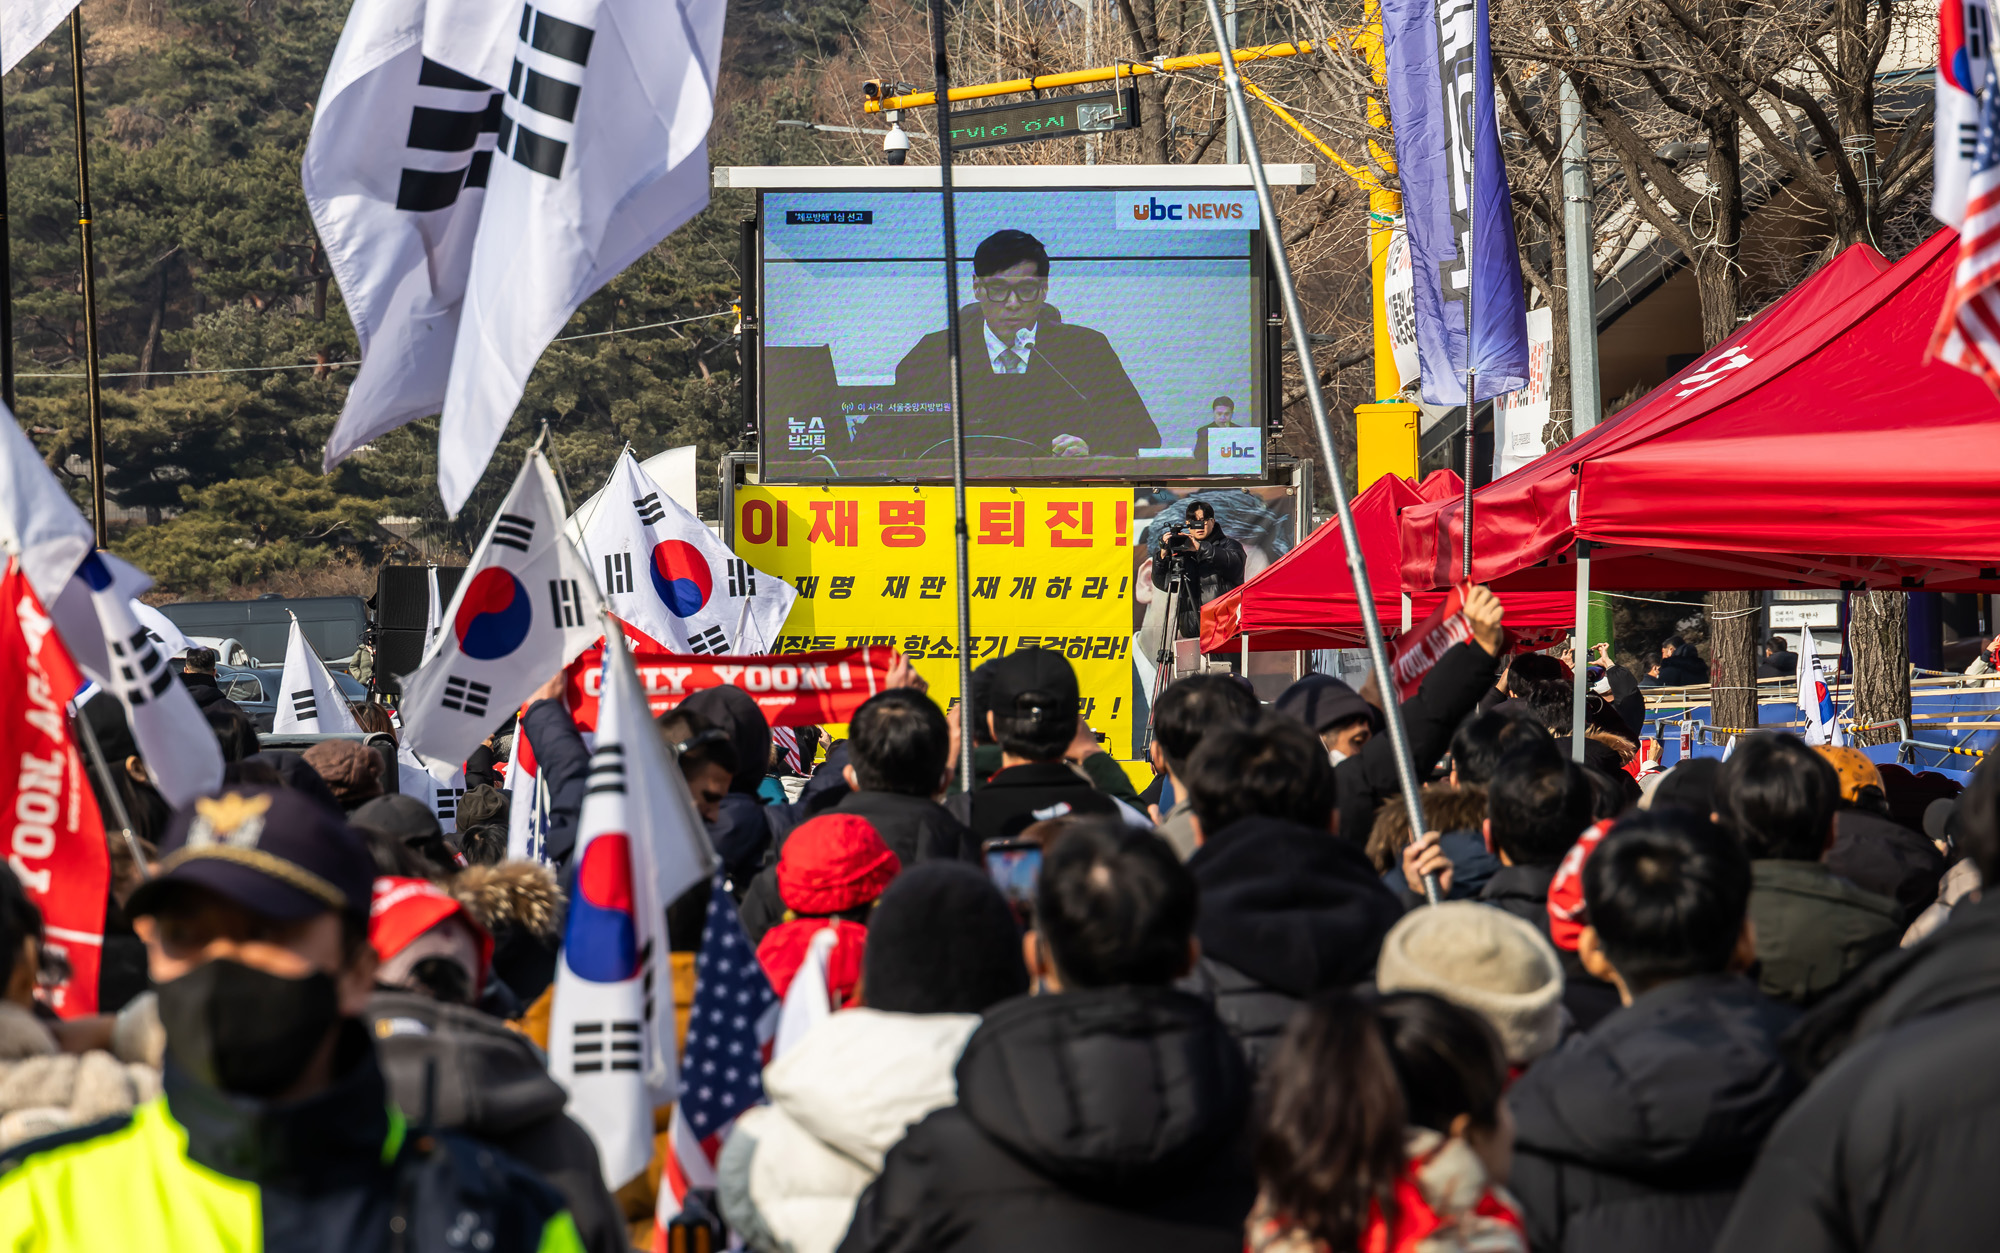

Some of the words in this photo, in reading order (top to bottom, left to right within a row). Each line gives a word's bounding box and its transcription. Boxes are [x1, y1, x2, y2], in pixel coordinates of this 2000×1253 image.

[1133, 196, 1183, 221] ubc
[1188, 203, 1243, 219] NEWS
[833, 212, 845, 223] 1심
[847, 212, 864, 222] 선고
[868, 402, 884, 412] 시각
[788, 416, 826, 434] 뉴스
[788, 434, 826, 447] 브리핑
[1220, 441, 1256, 458] ubc
[881, 576, 947, 600] 재판
[583, 666, 693, 698] OLY
